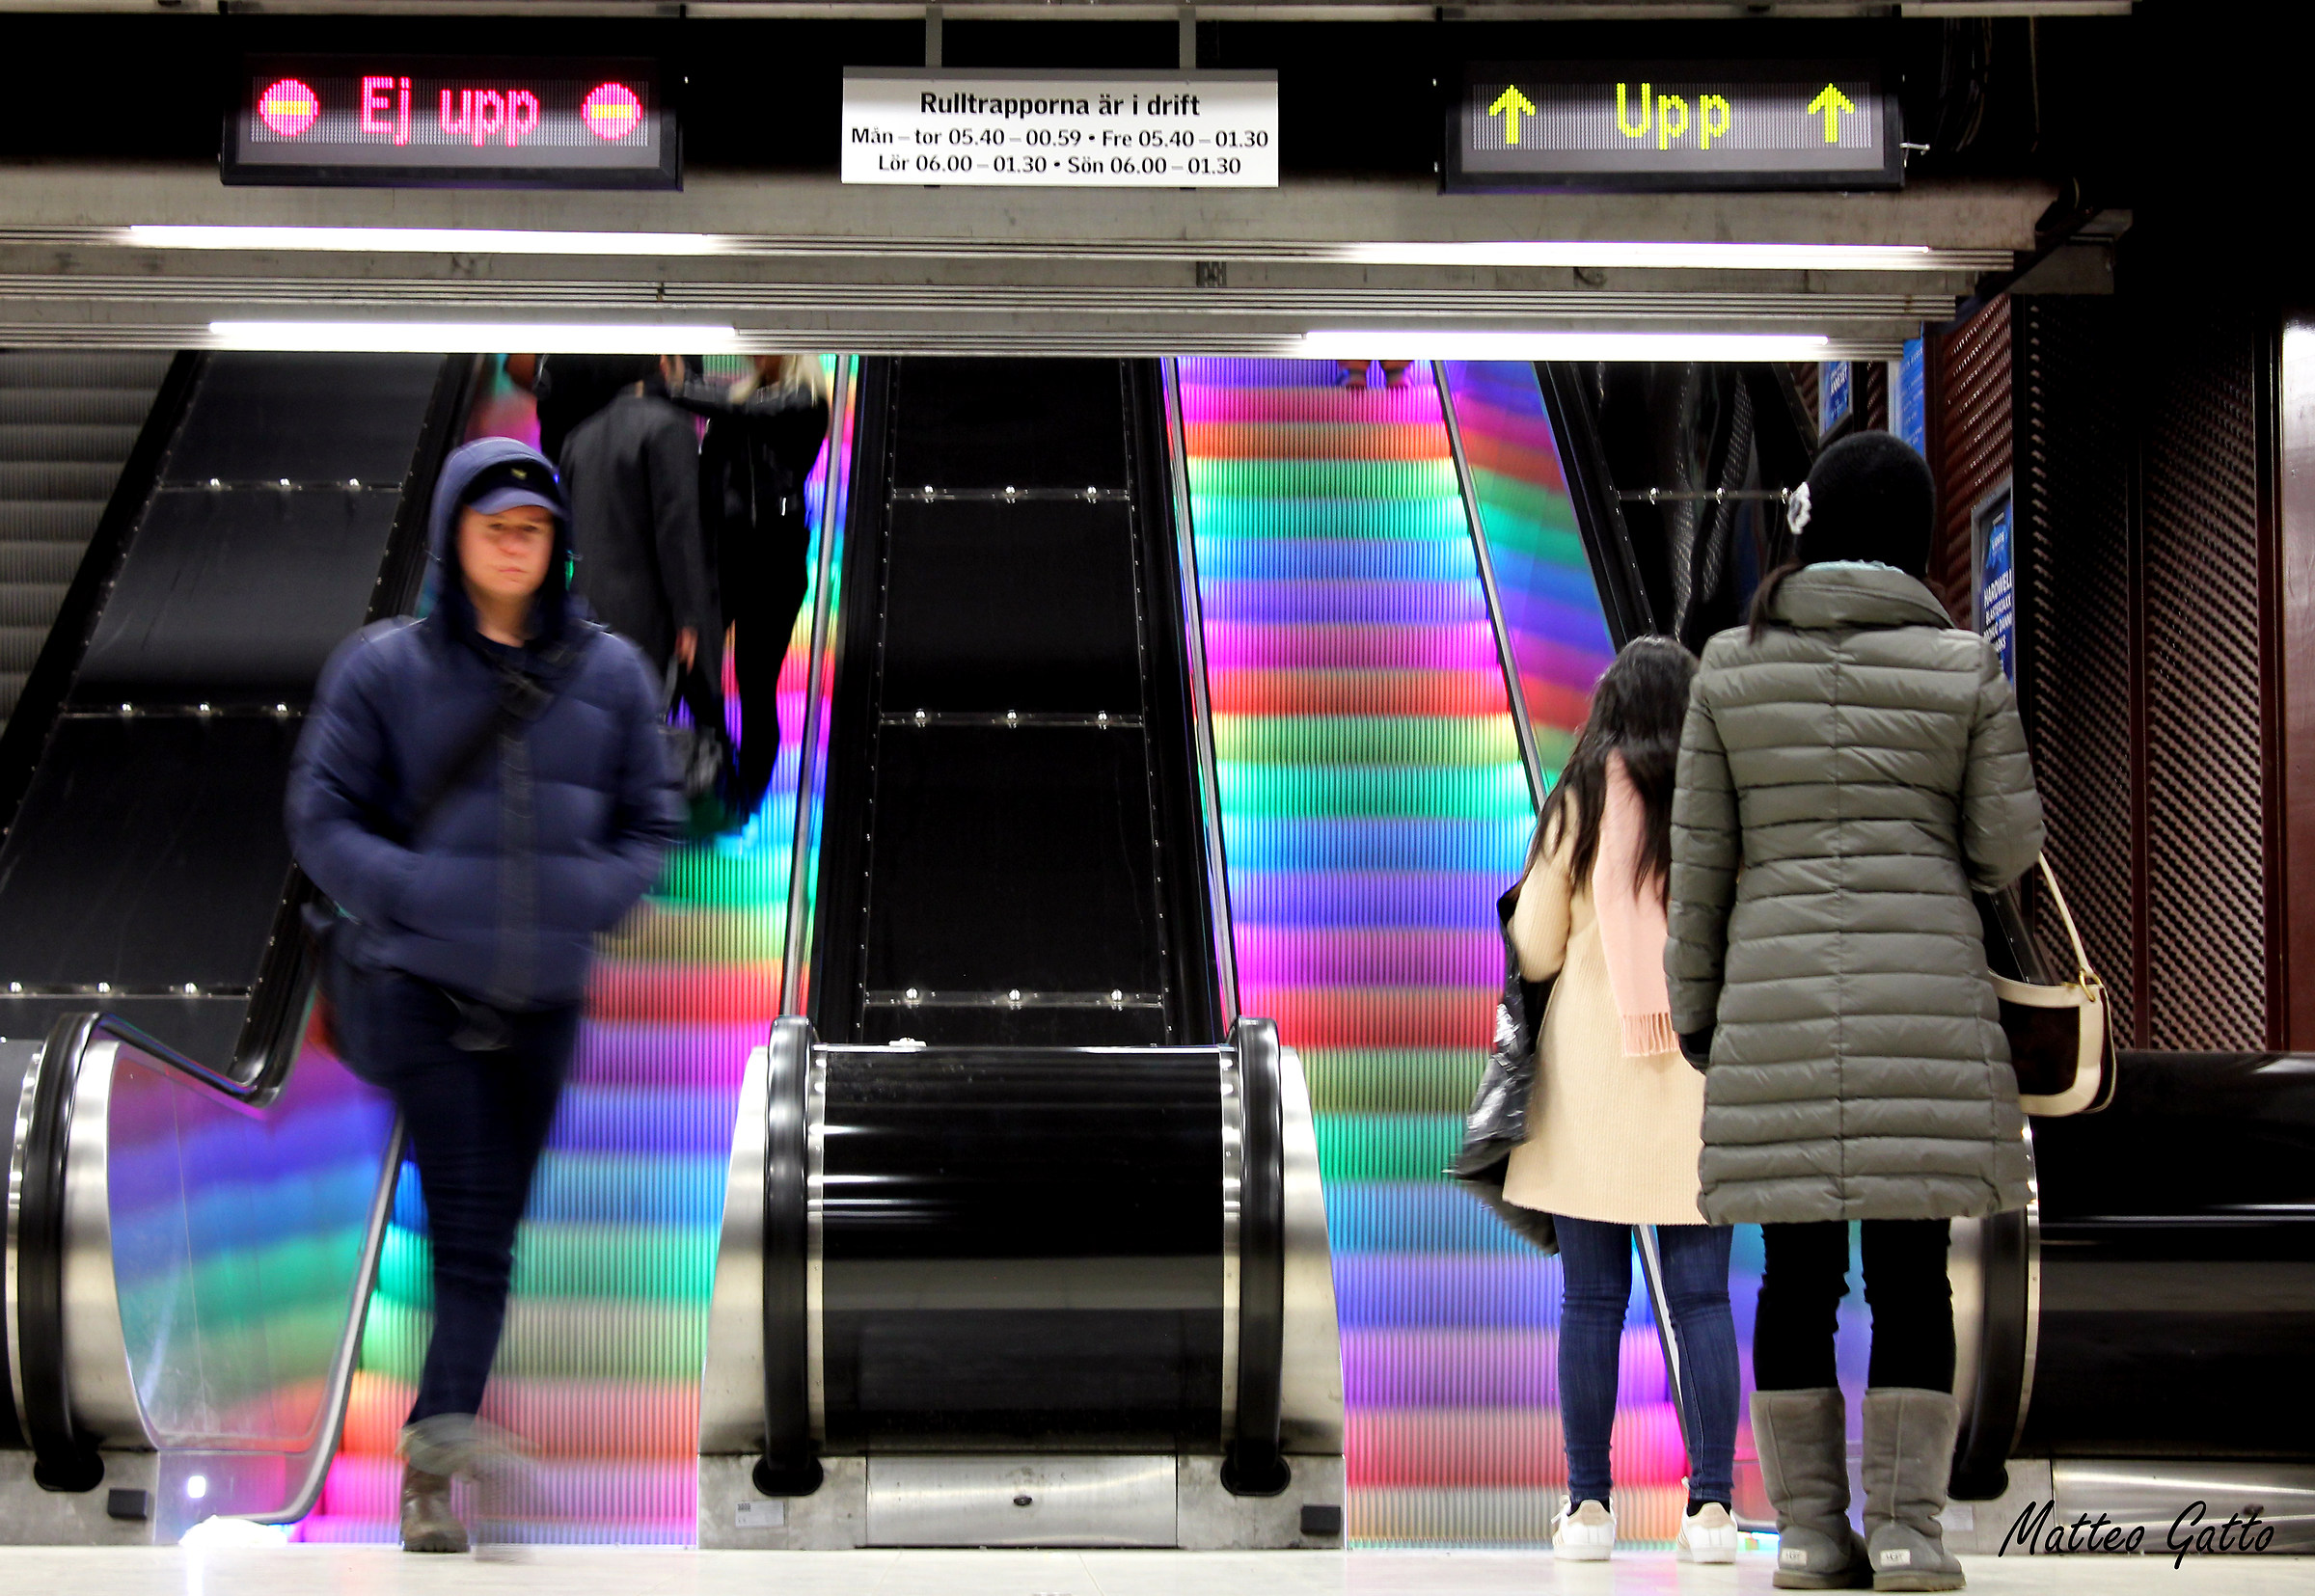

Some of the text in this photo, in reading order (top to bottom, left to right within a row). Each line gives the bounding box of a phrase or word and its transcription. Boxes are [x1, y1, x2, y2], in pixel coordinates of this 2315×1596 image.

[361, 75, 539, 147] Ej upp
[920, 92, 1200, 120] Rulltrapporna är i drift
[1616, 83, 1730, 150] Upp
[852, 126, 893, 144] Mån
[913, 129, 941, 145] tor
[948, 128, 1005, 146] 05.40
[1025, 129, 1081, 147] 00.59
[1103, 130, 1132, 147] Fre
[1138, 130, 1194, 148] 05.40
[1215, 130, 1268, 148] 01.30
[879, 154, 909, 171] Lör
[915, 154, 972, 172] 06.00
[994, 155, 1047, 173] 01.30
[1068, 155, 1103, 174] Sön
[1110, 156, 1166, 174] 06.00
[1187, 157, 1241, 175] 01.30
